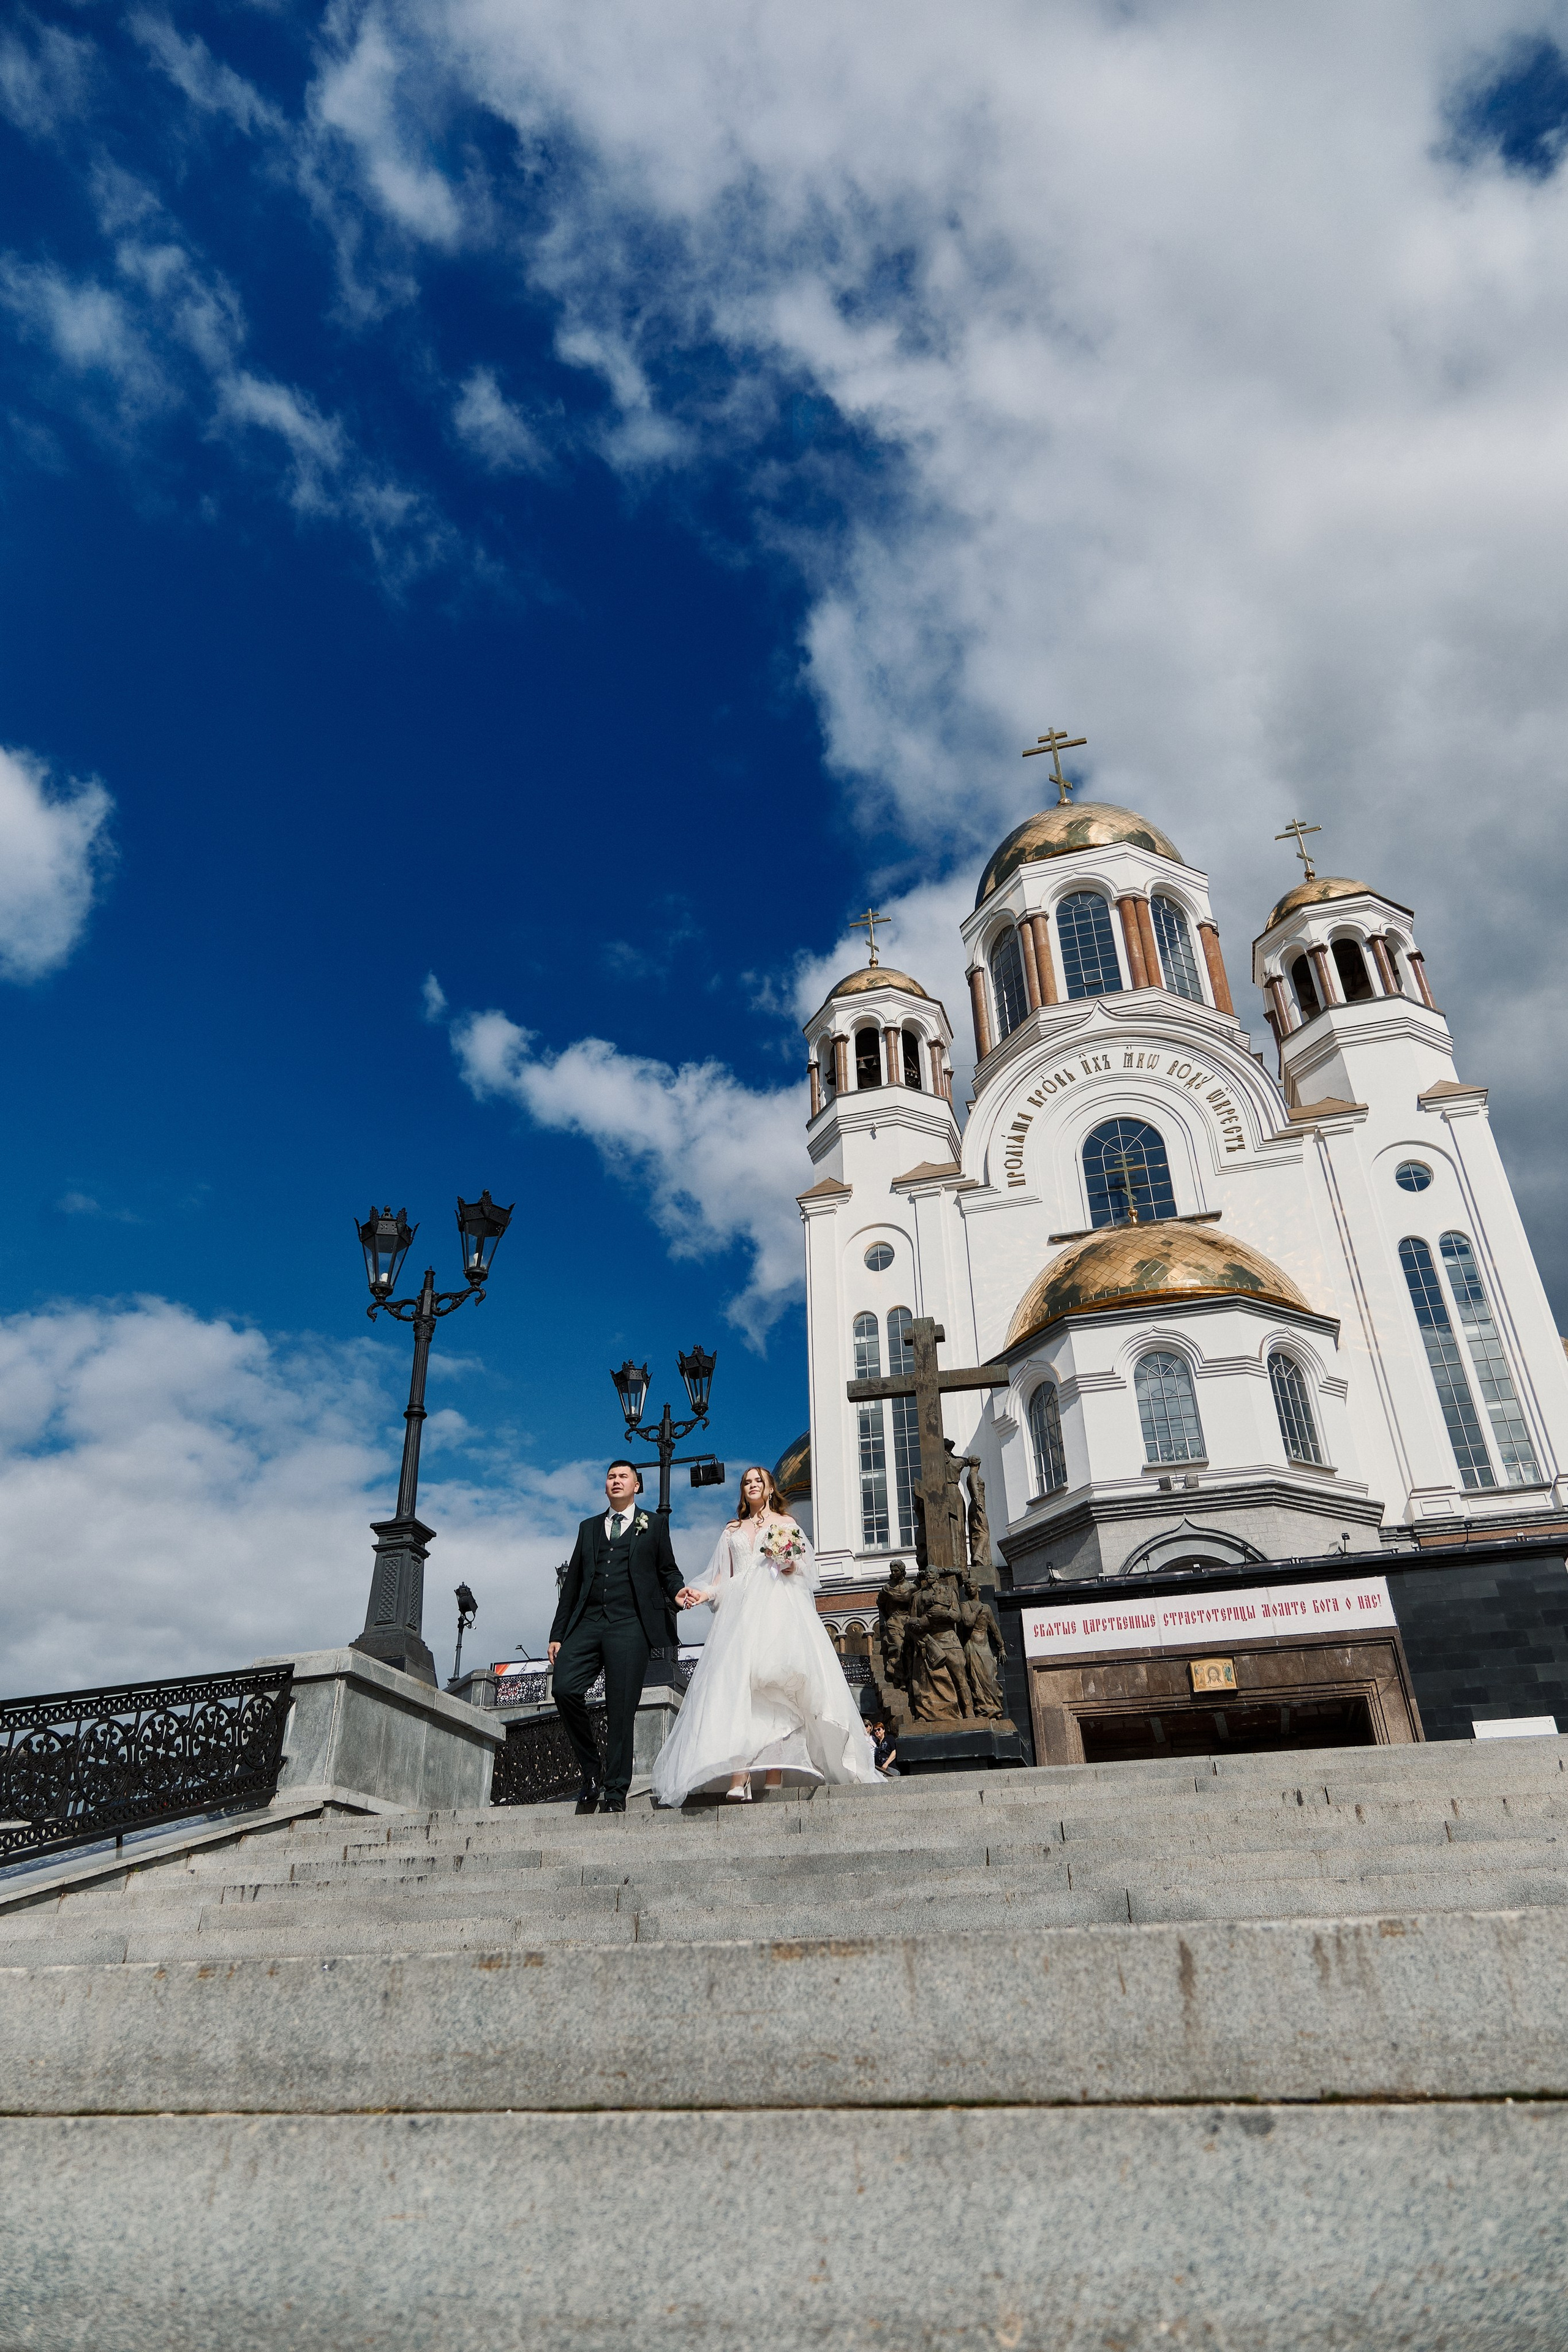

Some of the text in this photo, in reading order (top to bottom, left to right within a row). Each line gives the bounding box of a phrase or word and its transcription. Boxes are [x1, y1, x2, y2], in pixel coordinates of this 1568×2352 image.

[1082, 1613, 1156, 1635] ЦАРСТВЕННЫЕ
[1163, 1605, 1256, 1627] СТРАСТОТЕРПЦЫ
[1261, 1600, 1306, 1618] МОЛИТЕ
[1313, 1598, 1340, 1613] БОГА
[1345, 1597, 1352, 1610] О
[1357, 1594, 1382, 1610] НАС!
